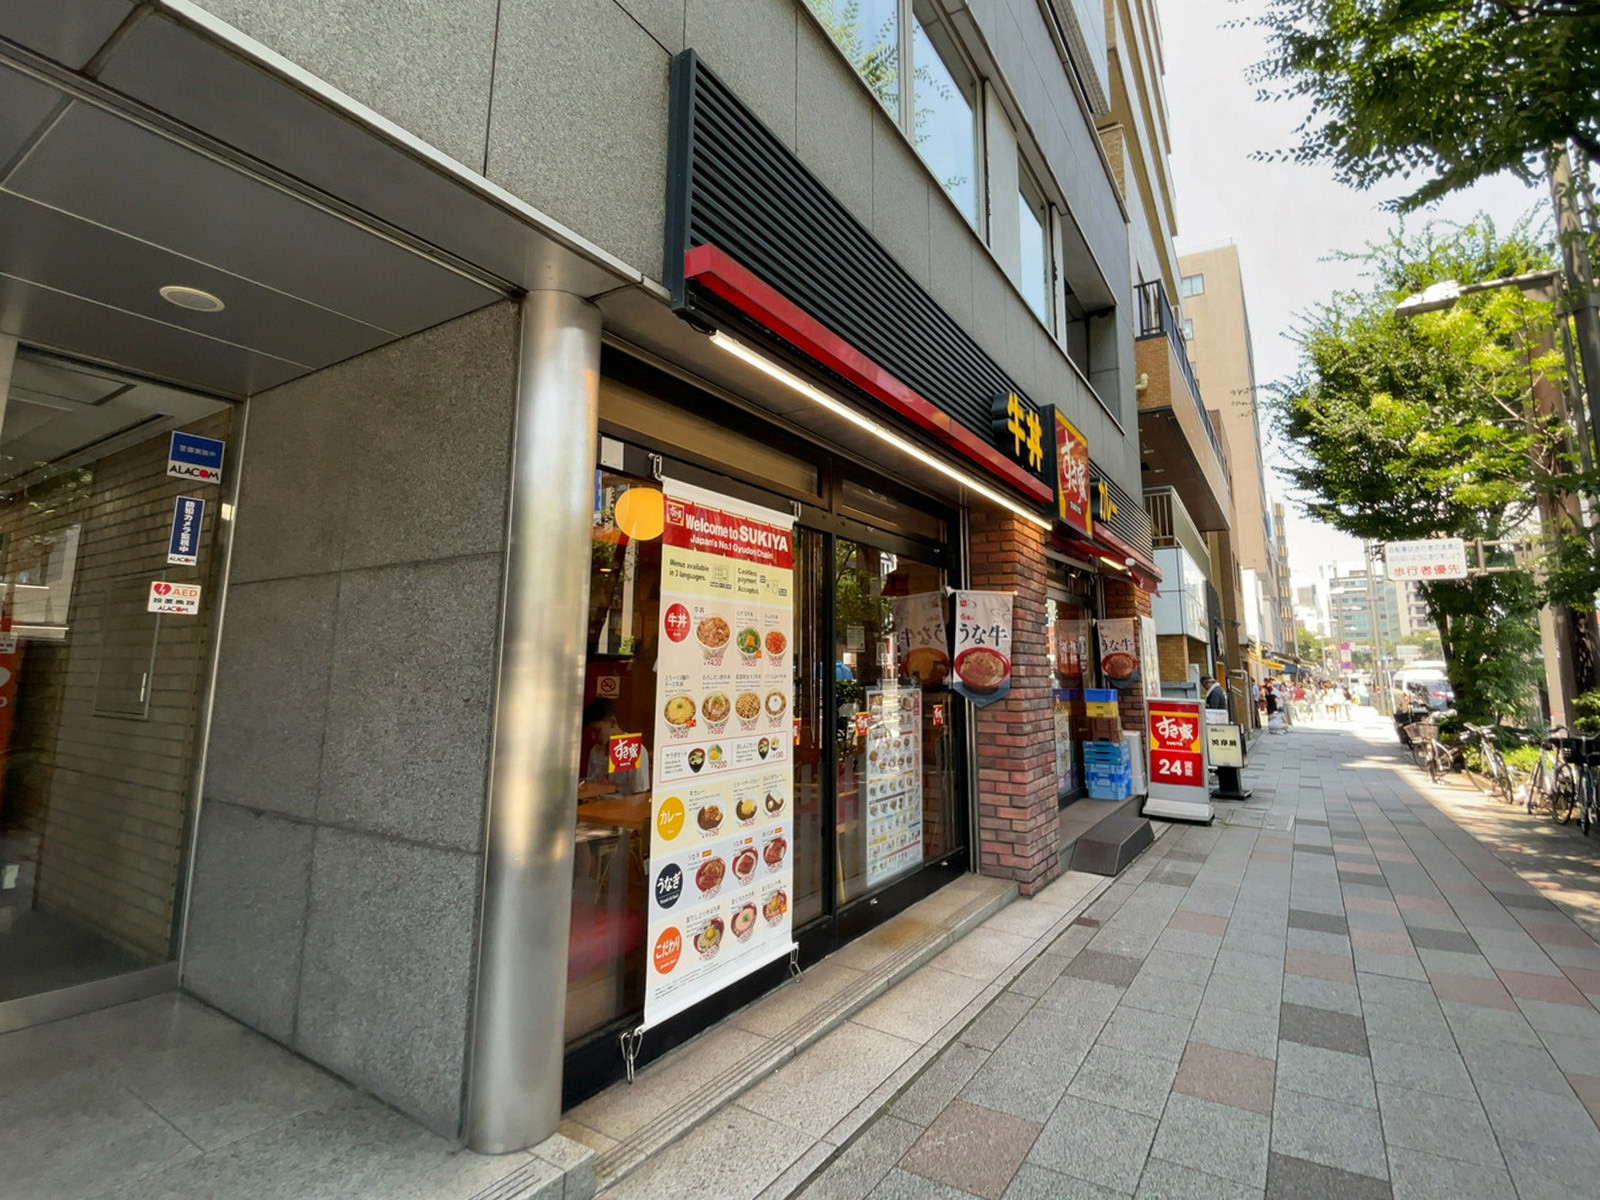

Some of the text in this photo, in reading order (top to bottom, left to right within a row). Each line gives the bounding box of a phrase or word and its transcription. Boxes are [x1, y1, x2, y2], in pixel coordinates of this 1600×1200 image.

[1007, 392, 1043, 472] 牛丼
[169, 464, 219, 480] ALACOM
[1061, 428, 1087, 504] すき家
[1098, 478, 1118, 522] カレー
[685, 513, 788, 552] Welcome to SUKIYA
[690, 535, 774, 559] Japan's No.1 Gyudon Chain
[687, 564, 709, 572] available
[1394, 564, 1461, 576] 歩行者優先
[172, 588, 198, 597] AED
[667, 612, 688, 628] 牛丼
[959, 622, 1008, 646] うな牛
[1101, 638, 1133, 651] うな牛
[1155, 716, 1194, 741] すき家
[614, 739, 638, 761] すき家
[1159, 759, 1182, 776] 24
[660, 810, 682, 825] カレー
[657, 871, 681, 894] うなぎ
[656, 936, 680, 959] こだわり
